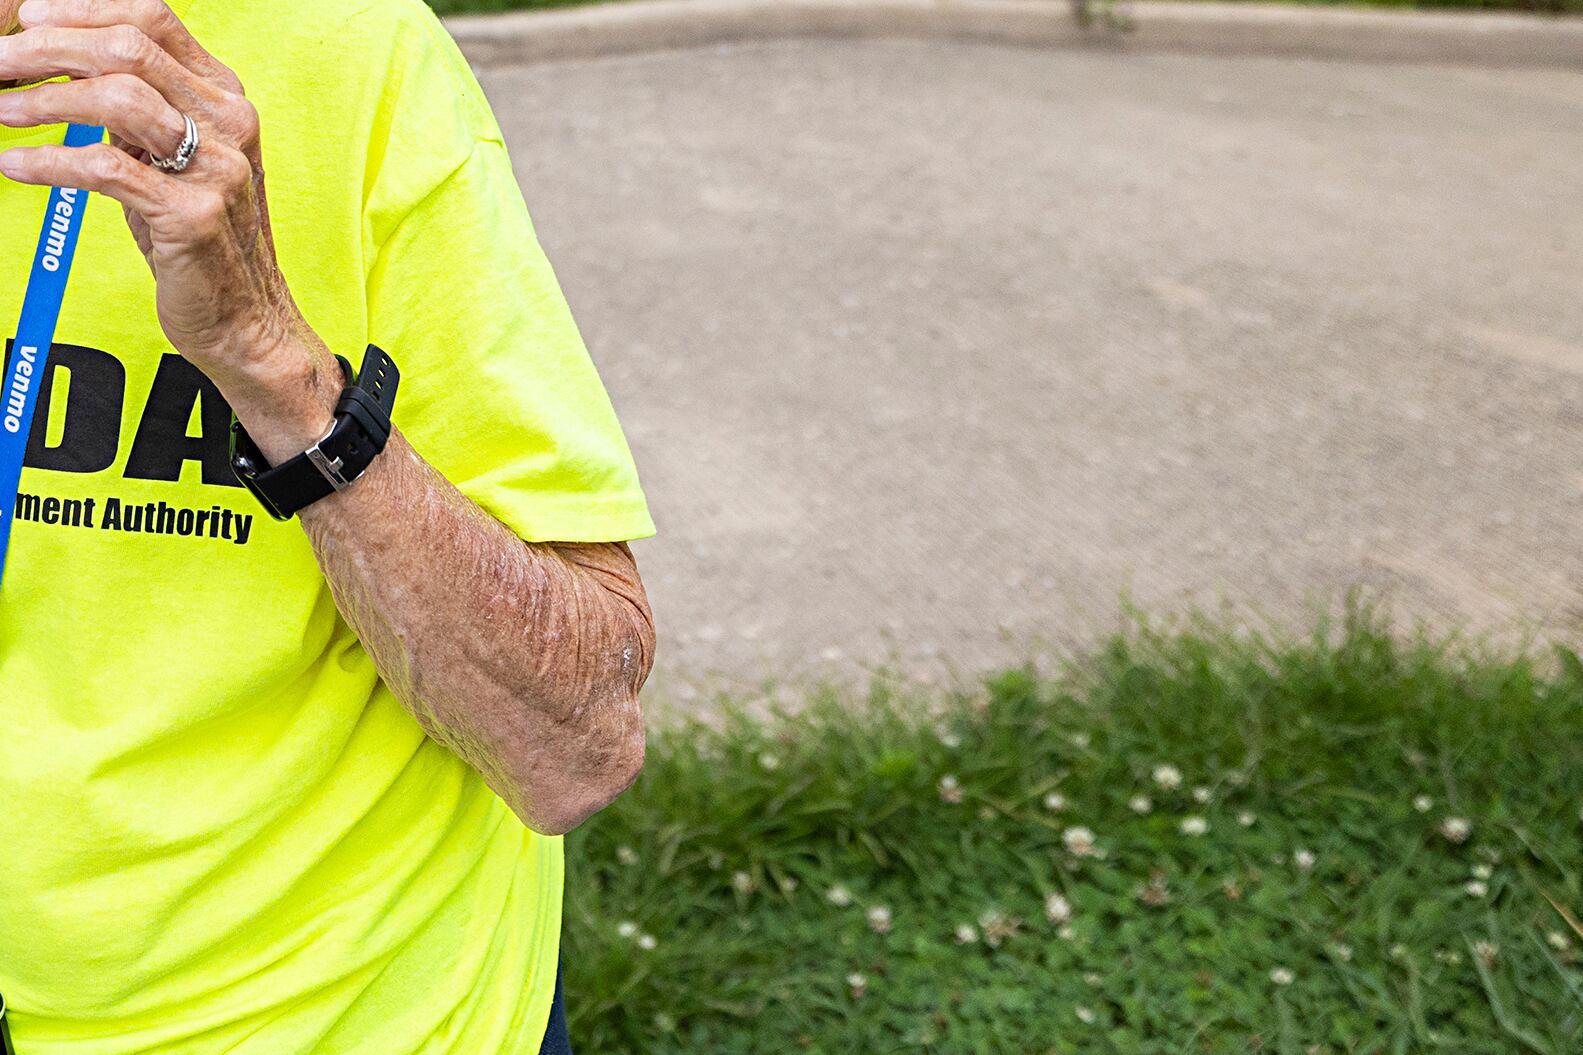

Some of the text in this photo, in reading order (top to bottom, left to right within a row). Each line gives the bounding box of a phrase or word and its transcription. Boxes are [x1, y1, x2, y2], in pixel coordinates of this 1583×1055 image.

[42, 186, 78, 272] venmo
[4, 346, 37, 433] venmo
[101, 497, 253, 545] Authority
